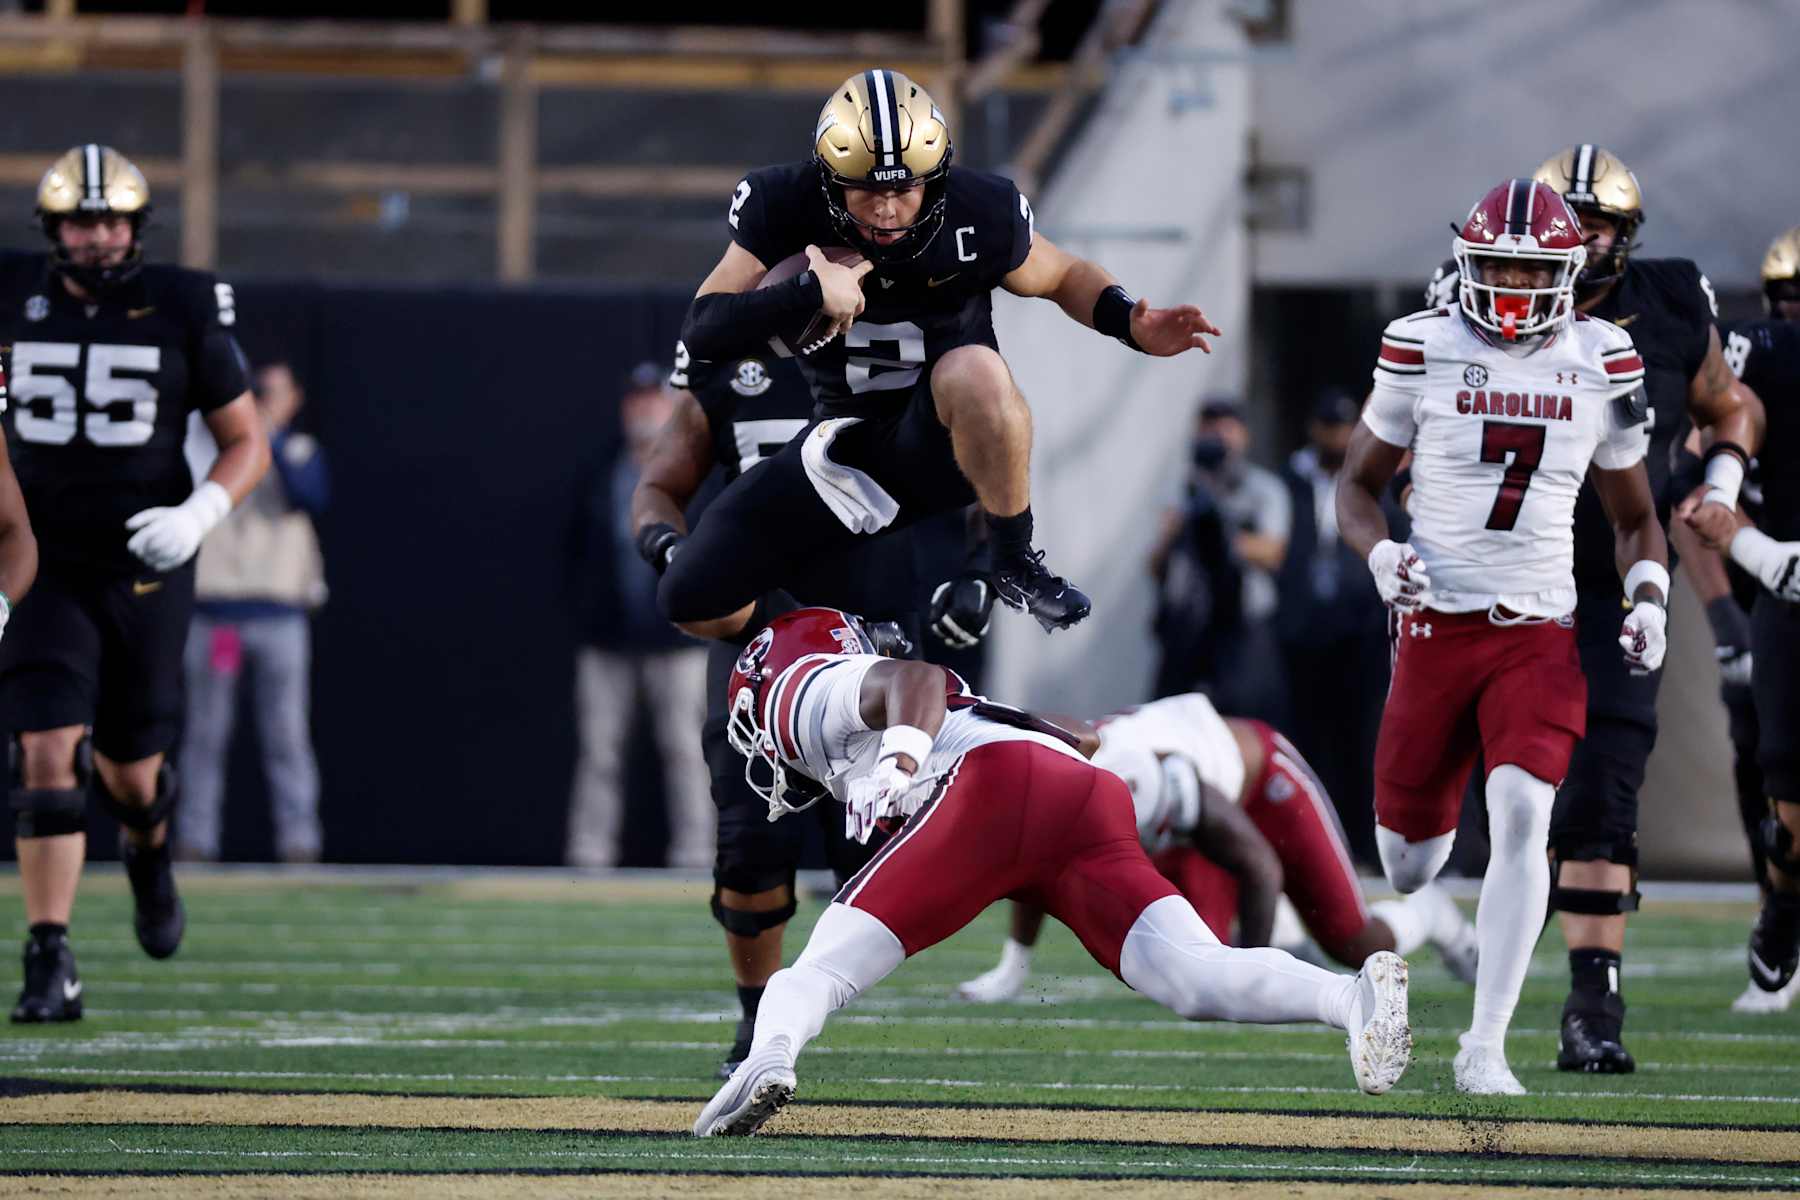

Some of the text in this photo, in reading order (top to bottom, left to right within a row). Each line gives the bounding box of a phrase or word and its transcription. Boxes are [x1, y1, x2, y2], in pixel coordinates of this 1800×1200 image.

[874, 169, 906, 181] VUFB
[728, 180, 751, 231] 2
[955, 226, 977, 262] C
[844, 320, 926, 395] 2
[1465, 365, 1488, 387] SEC
[10, 341, 161, 446] 55
[1456, 390, 1573, 421] CAROLINA
[1480, 420, 1547, 531] 7
